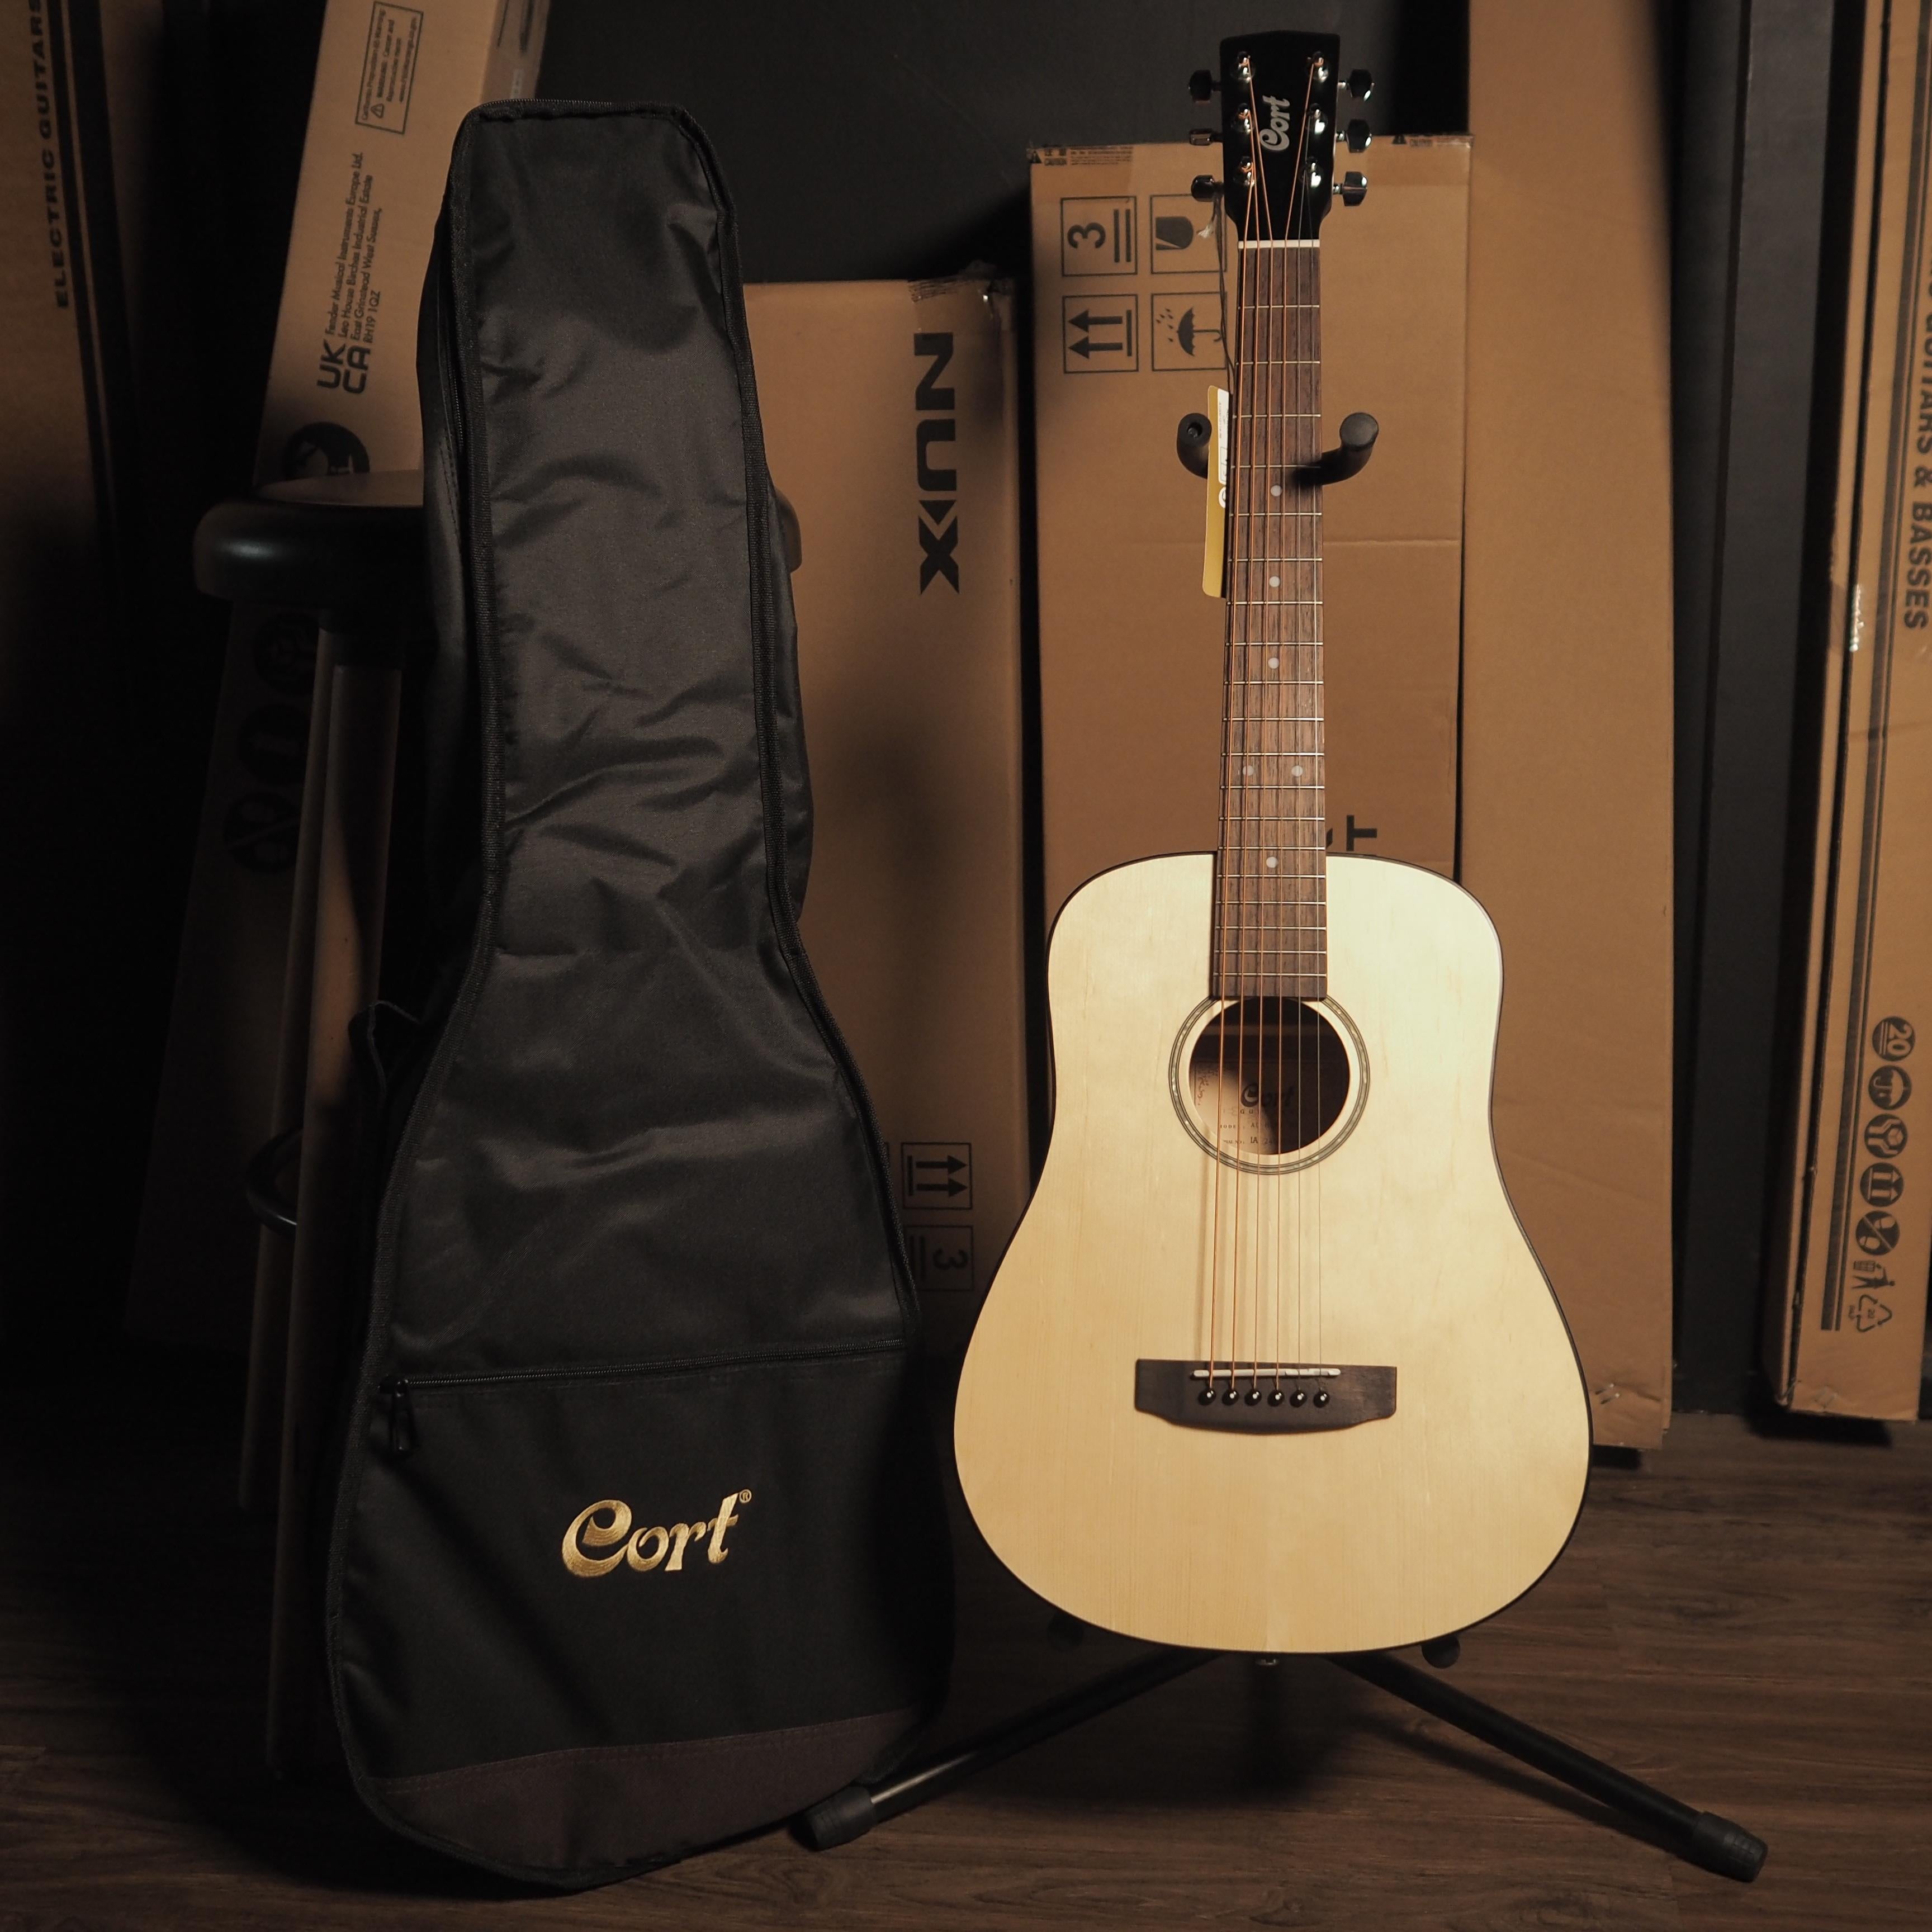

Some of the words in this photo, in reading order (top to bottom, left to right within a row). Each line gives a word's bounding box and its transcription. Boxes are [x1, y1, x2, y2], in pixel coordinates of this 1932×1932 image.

[29, 0, 51, 139] GUITARS
[1259, 95, 1290, 151] Cort
[360, 174, 372, 203] Estate
[44, 149, 68, 308] ELECTRIC
[353, 205, 367, 249] Industrial
[1067, 222, 1106, 248] 3
[326, 302, 338, 335] Fender
[332, 262, 345, 300] Musical
[346, 171, 361, 205] Europe
[363, 244, 375, 268] West
[342, 288, 354, 318] House
[356, 271, 370, 318] Grinstead
[369, 290, 380, 312] 1QZ
[339, 320, 349, 338] Leo
[352, 320, 362, 340] East
[364, 316, 376, 343] RH19
[318, 339, 345, 389] UK
[344, 345, 371, 394] CA
[913, 332, 960, 595] NUX
[1904, 503, 1932, 629] BASSES
[1887, 1024, 1912, 1056] 20
[933, 1249, 969, 1270] 3
